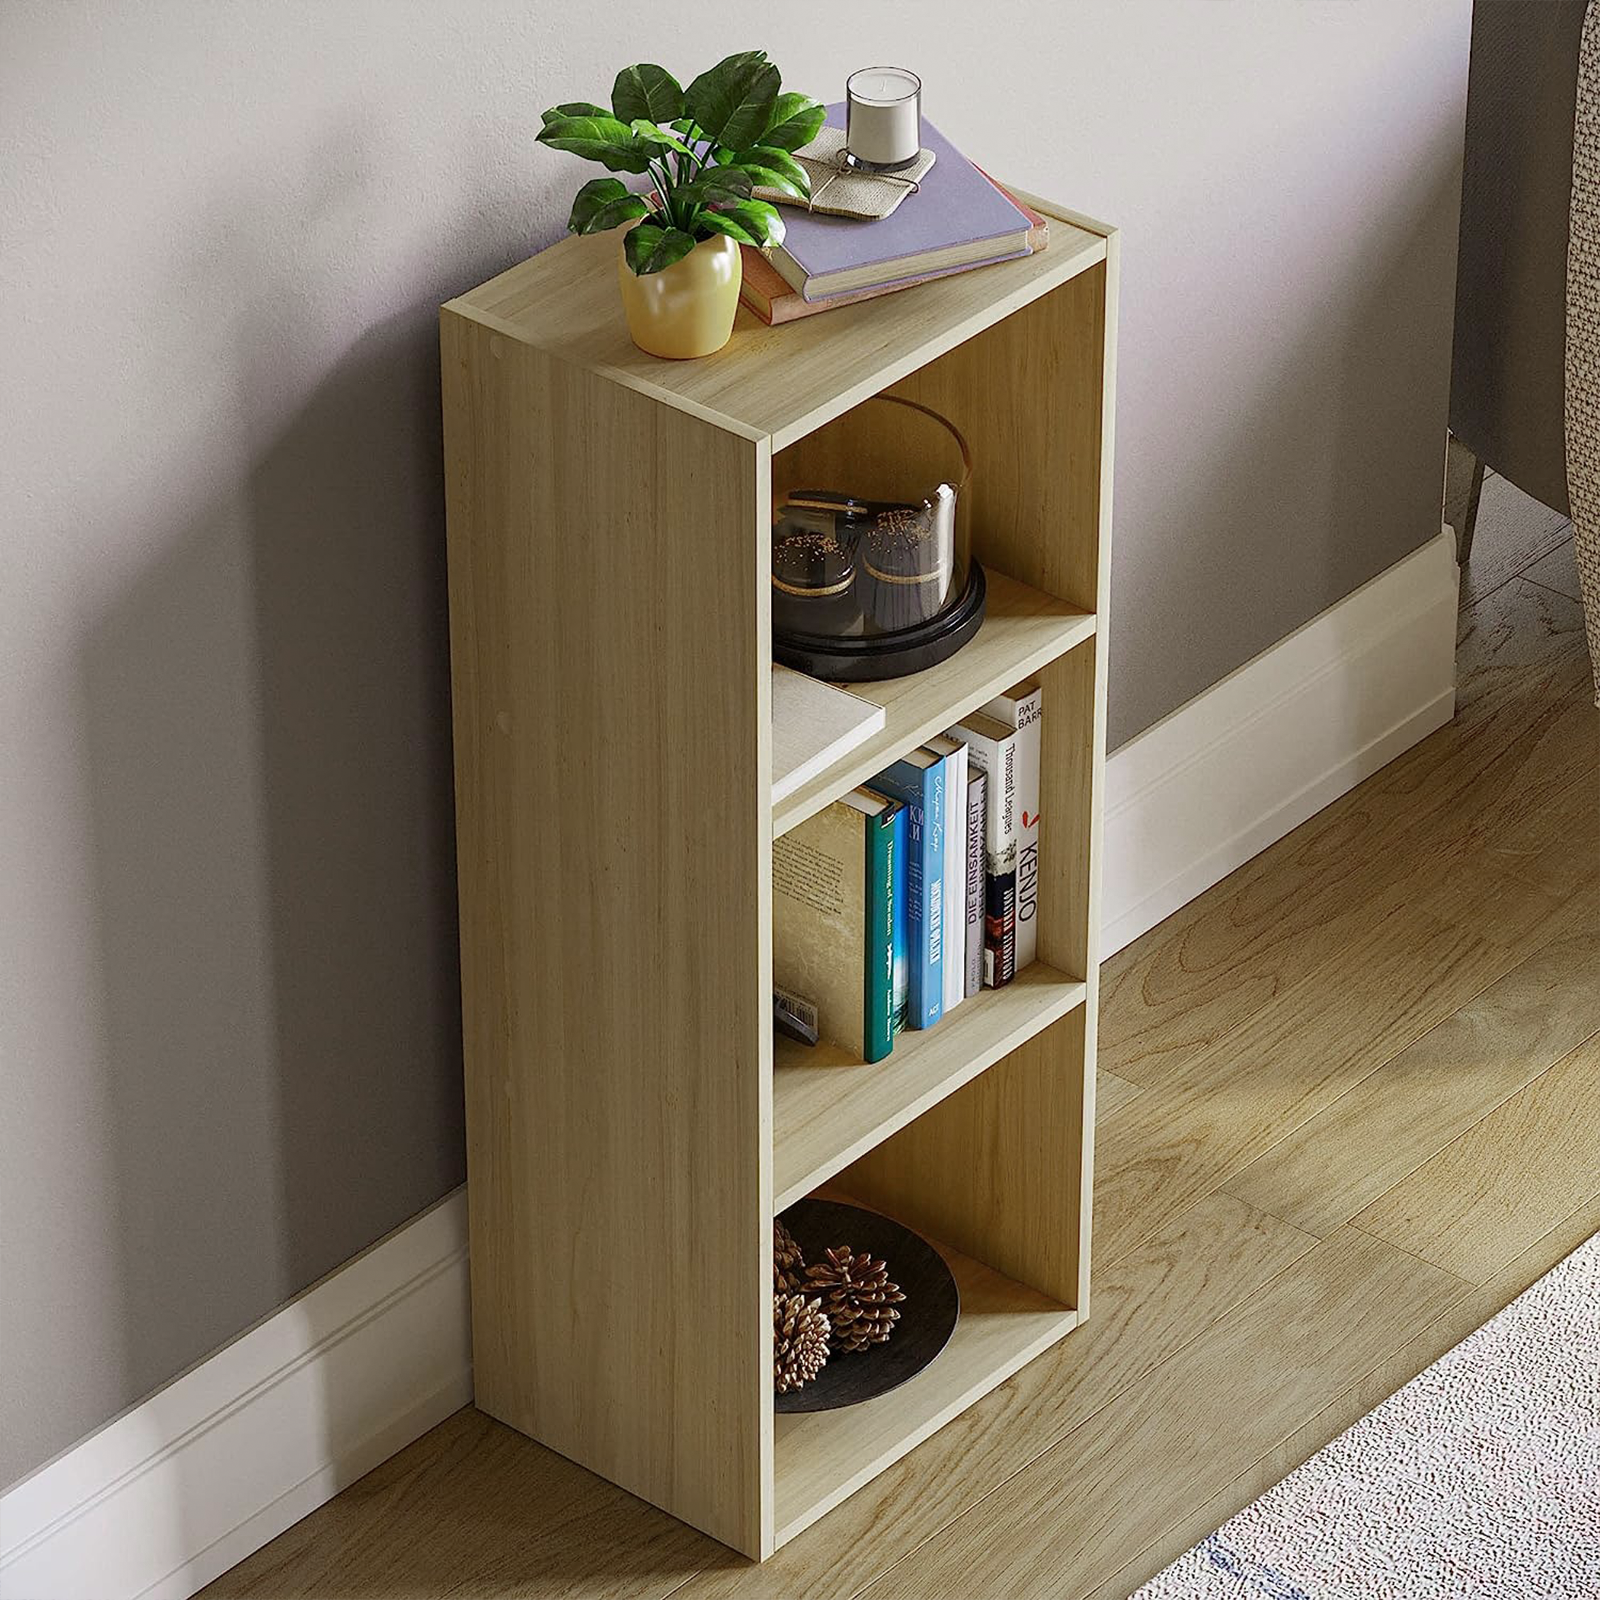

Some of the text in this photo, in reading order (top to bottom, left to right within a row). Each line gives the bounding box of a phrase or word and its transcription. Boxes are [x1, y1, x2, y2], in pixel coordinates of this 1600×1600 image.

[1018, 700, 1036, 717] PAT
[1002, 743, 1016, 835] Thousand Leagues
[968, 802, 979, 925] DIE EINSAMKEIT
[1018, 841, 1038, 923] KENJO
